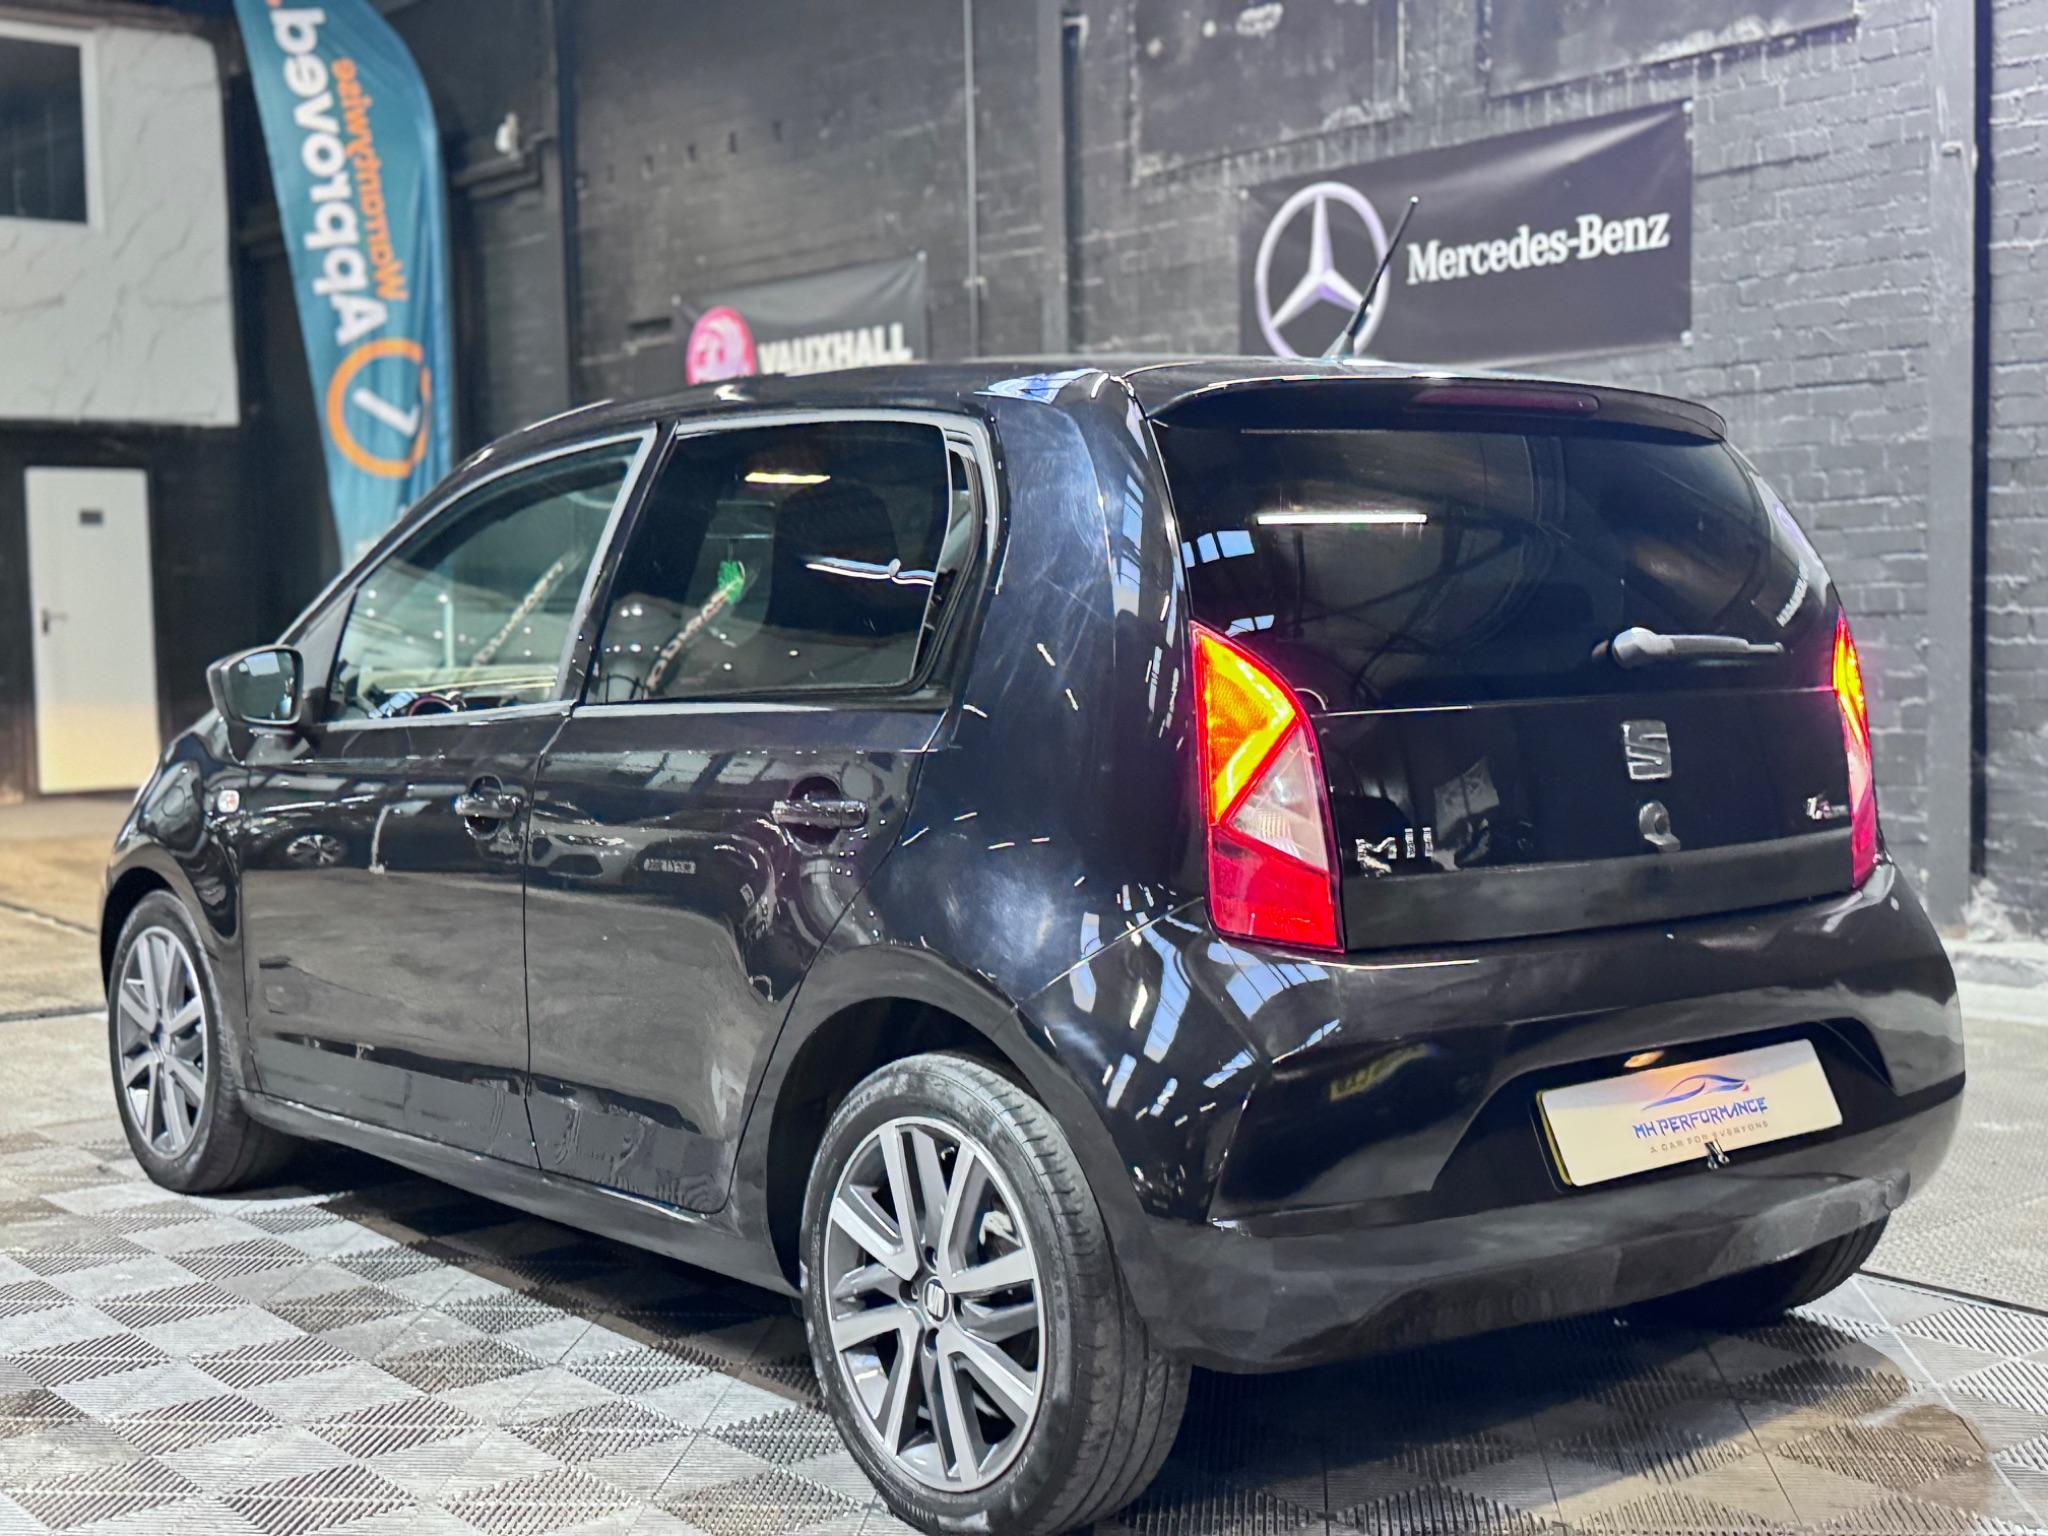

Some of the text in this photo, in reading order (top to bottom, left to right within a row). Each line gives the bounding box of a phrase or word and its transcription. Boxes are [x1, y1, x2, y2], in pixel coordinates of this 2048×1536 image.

[1406, 212, 1672, 285] Mercedes-Benz
[757, 321, 913, 377] VAUXHALL
[1632, 1096, 1768, 1139] MH PERFORMANCE
